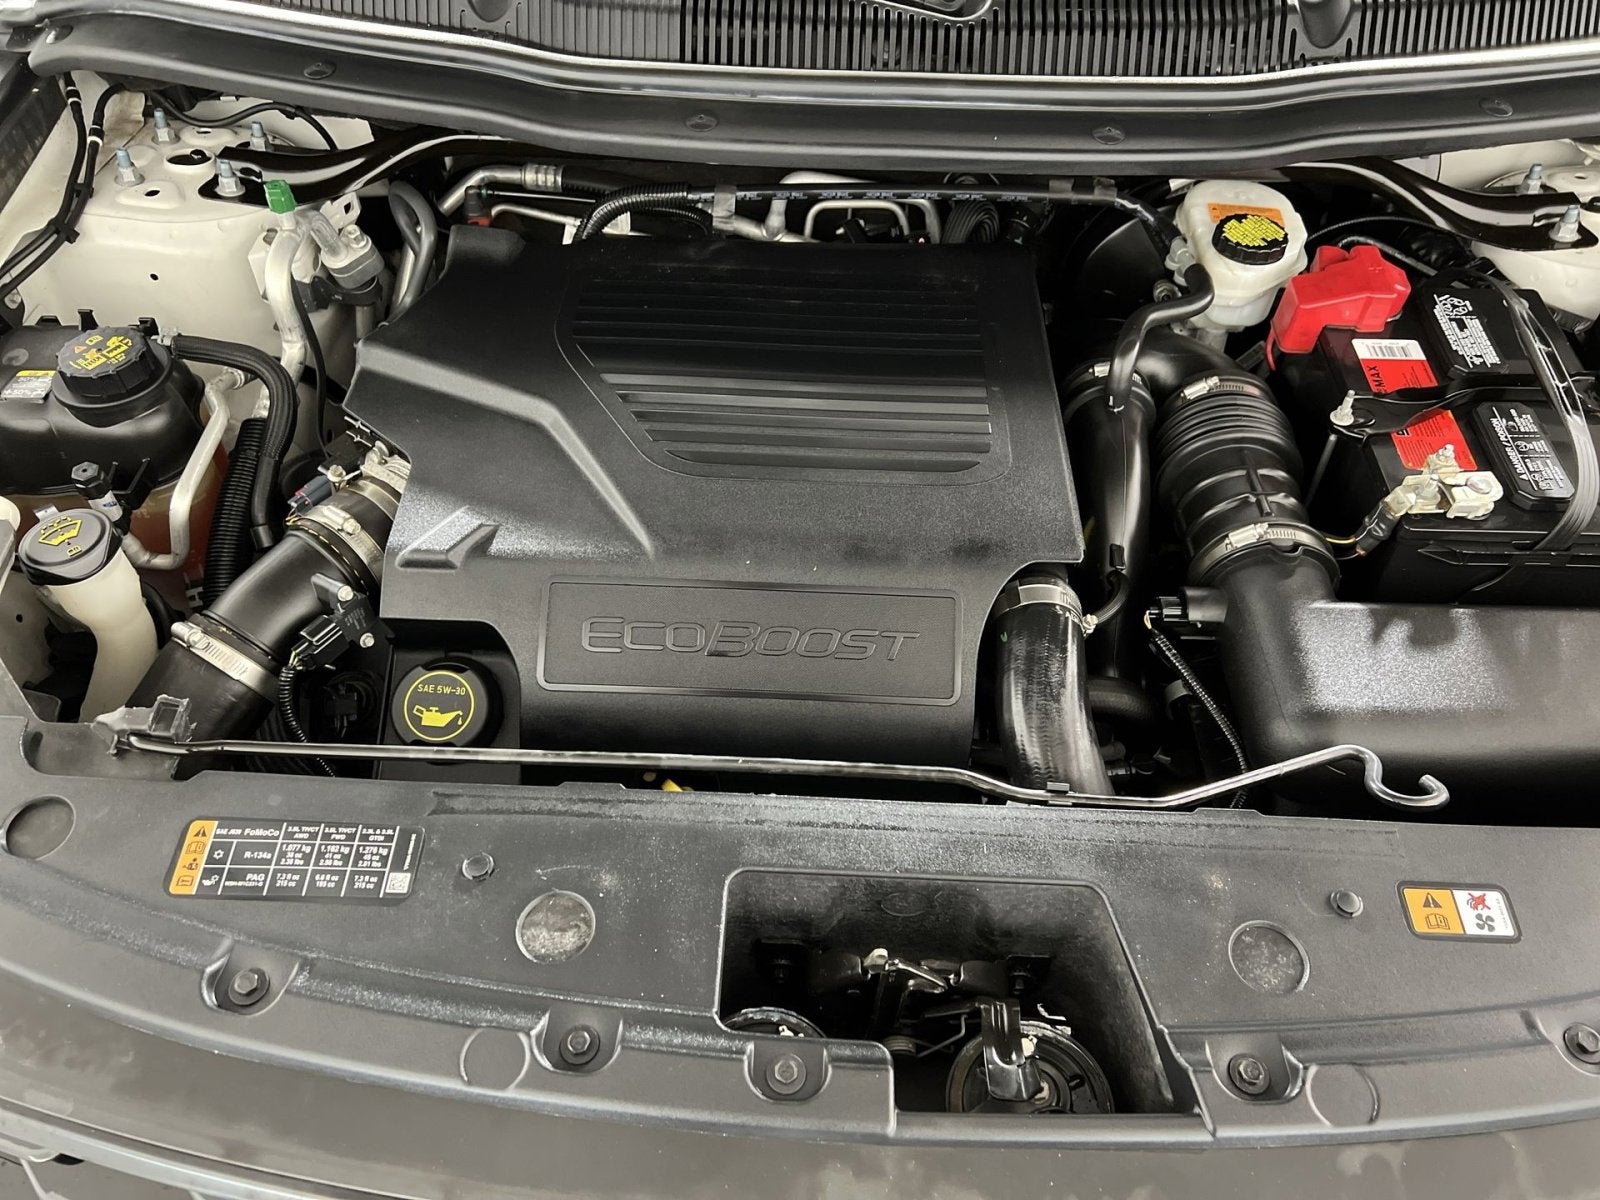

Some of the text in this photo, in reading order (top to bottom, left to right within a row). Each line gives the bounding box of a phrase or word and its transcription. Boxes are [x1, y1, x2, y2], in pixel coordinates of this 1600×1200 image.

[1490, 418, 1509, 441] POISON
[1505, 447, 1525, 473] DANGER
[417, 684, 466, 696] SAE 5W-30
[244, 828, 280, 837] FoMoCo
[301, 844, 312, 853] kg
[340, 845, 350, 854] kg
[378, 847, 388, 856] kg
[244, 851, 272, 860] R-134a
[246, 873, 265, 881] PAG
